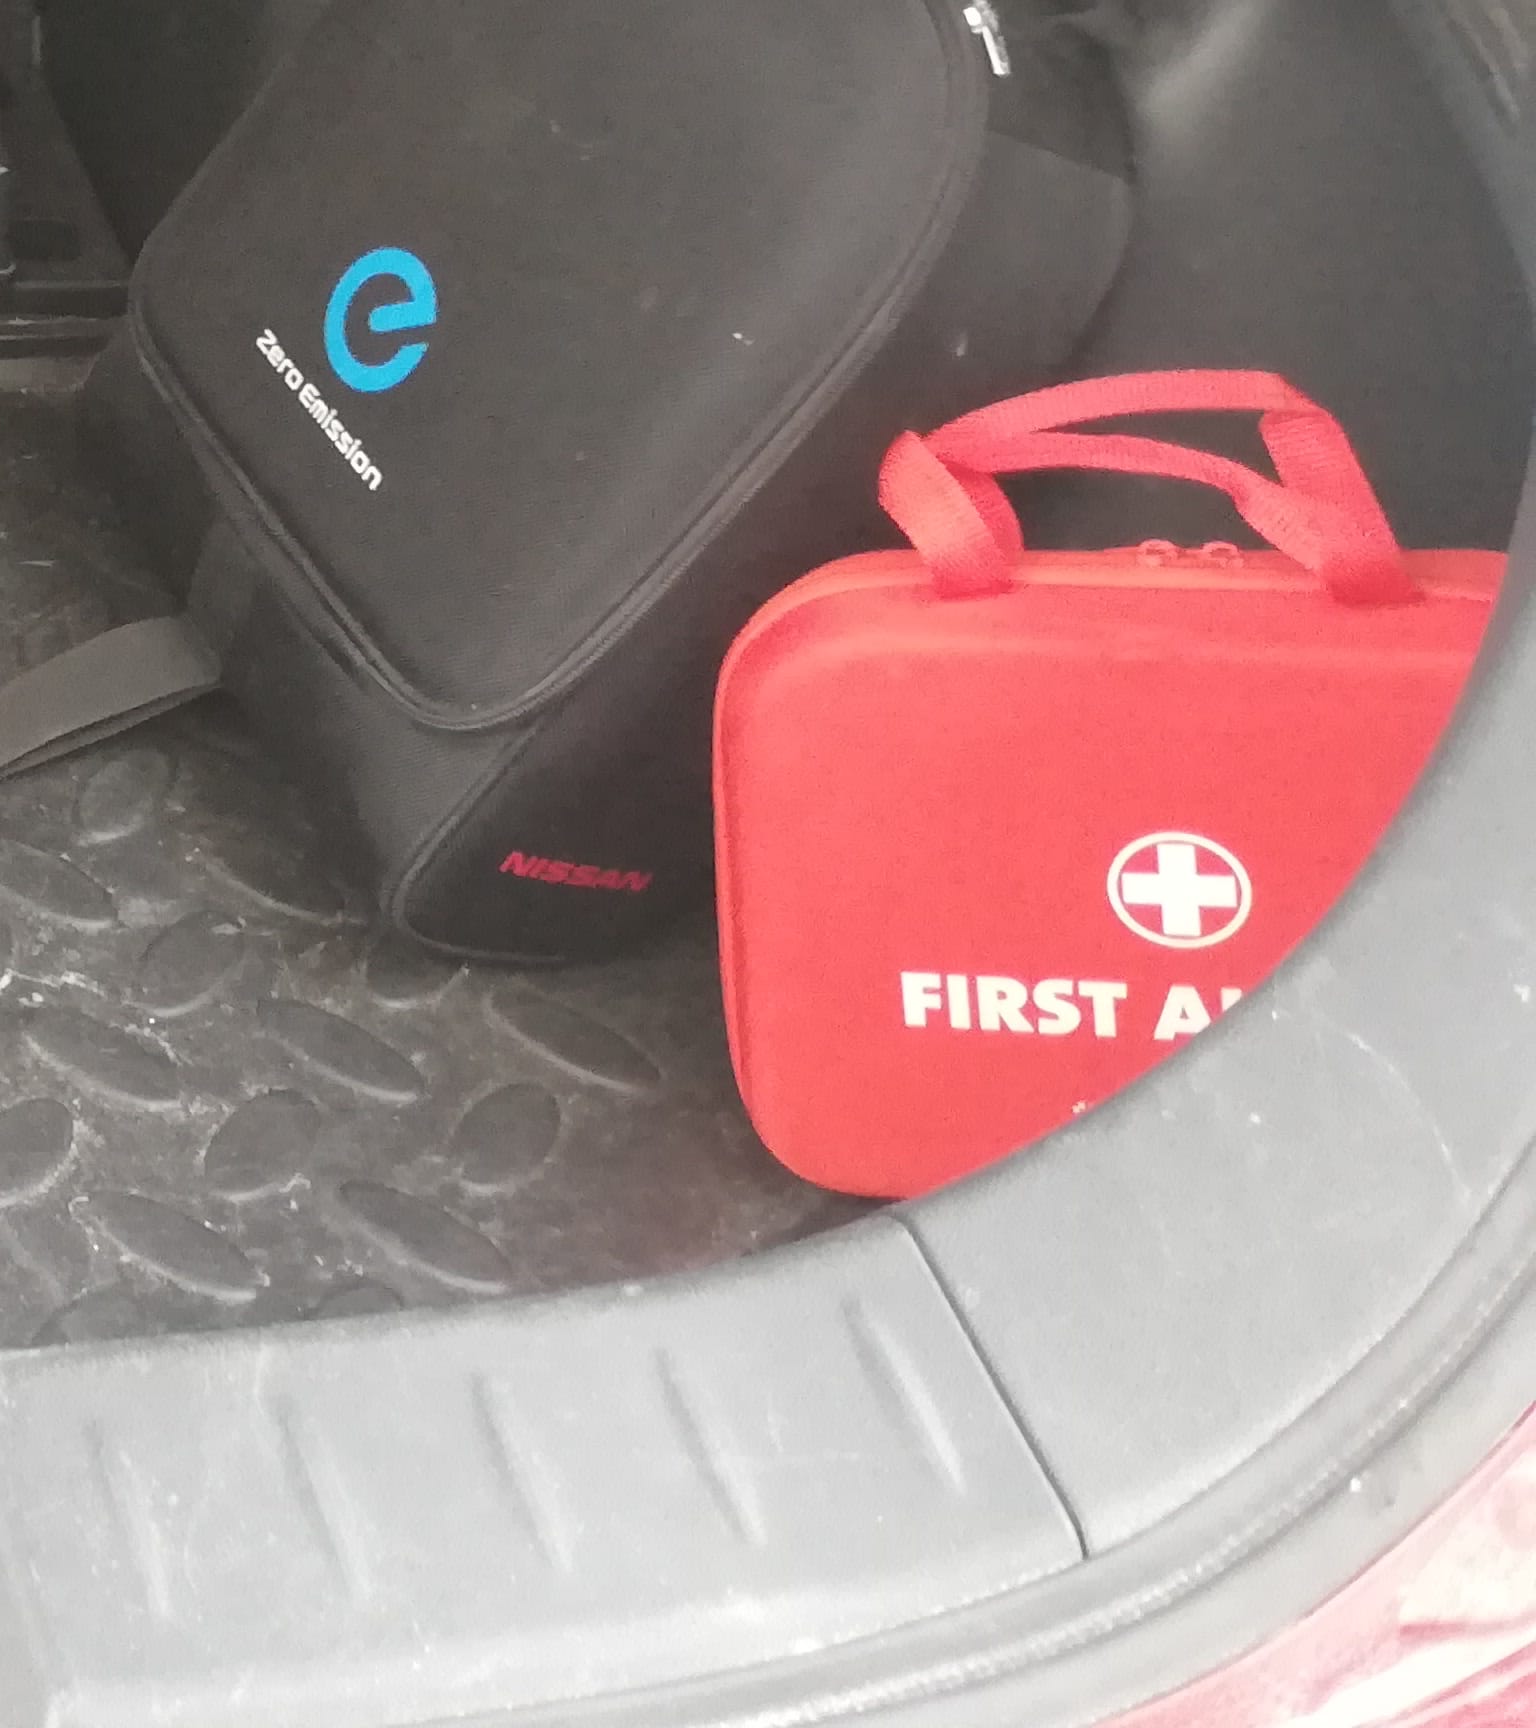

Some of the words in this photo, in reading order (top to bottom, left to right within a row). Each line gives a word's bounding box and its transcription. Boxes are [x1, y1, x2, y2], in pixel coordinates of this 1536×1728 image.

[324, 246, 437, 393] e
[255, 328, 305, 392] Zero
[298, 382, 384, 491] Emission
[499, 851, 652, 892] NISSAN
[900, 971, 1128, 1038] FIRST
